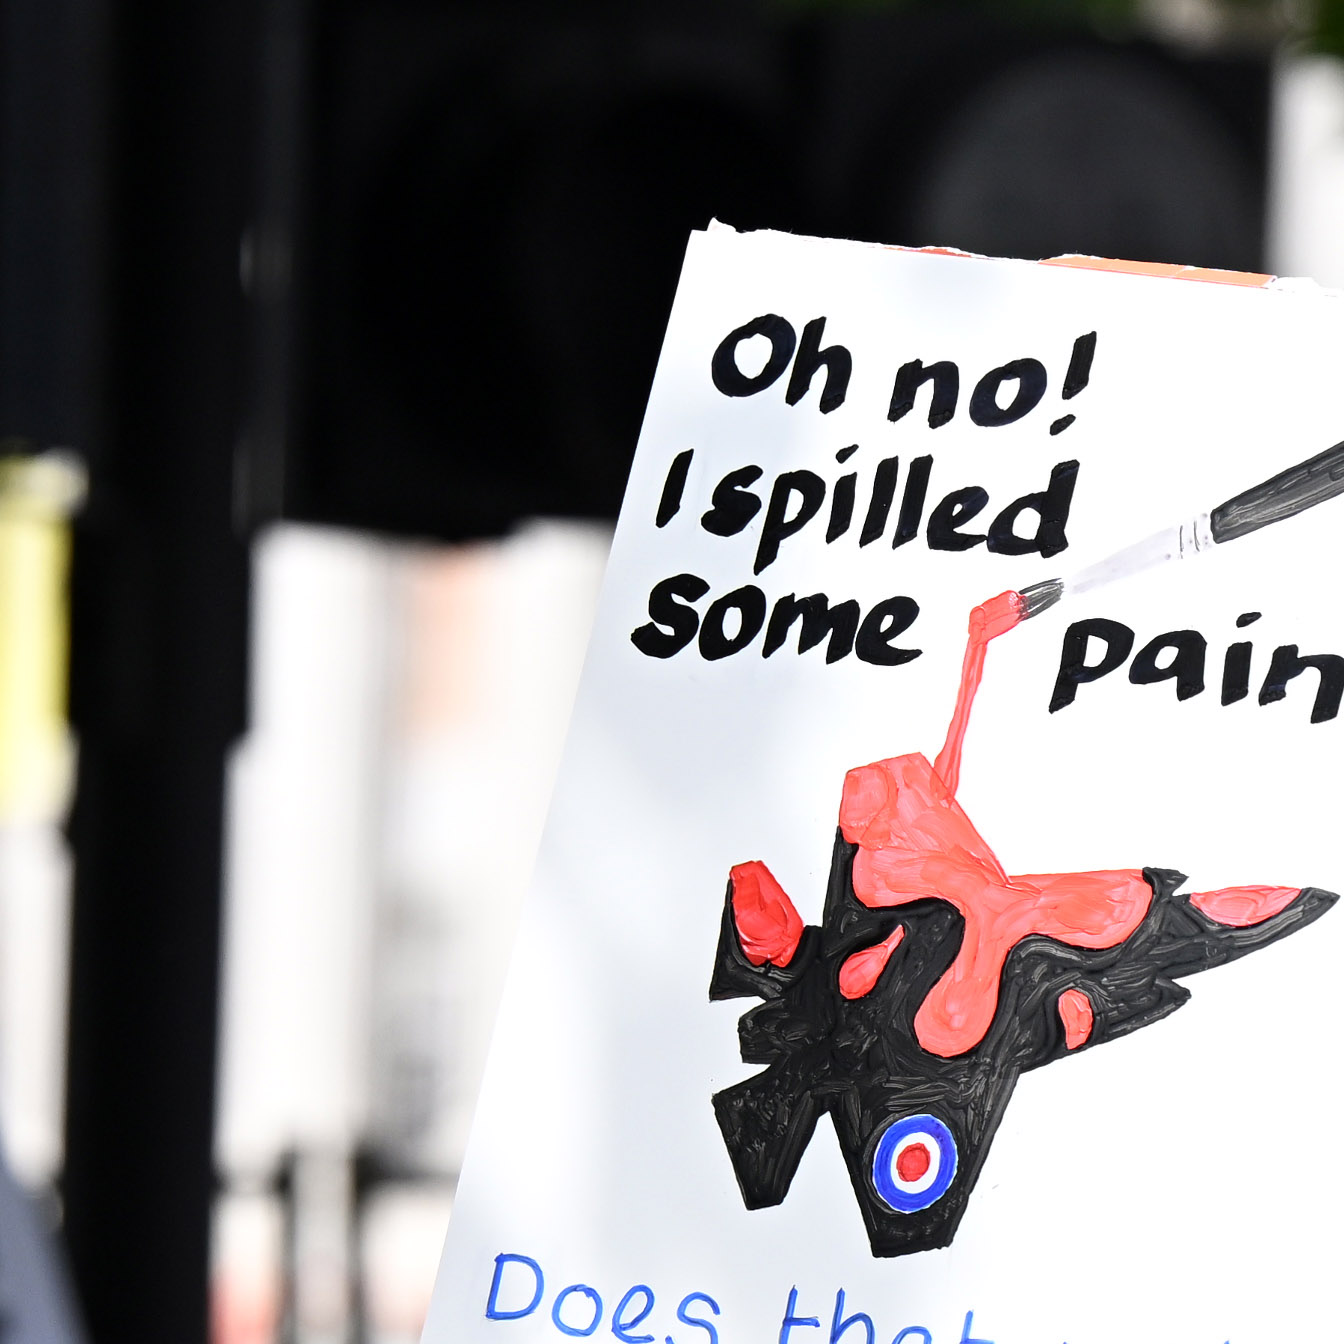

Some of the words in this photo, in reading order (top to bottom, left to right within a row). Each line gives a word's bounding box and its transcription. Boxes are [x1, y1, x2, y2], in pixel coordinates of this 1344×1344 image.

[711, 313, 853, 415] Oh
[887, 330, 1097, 436] no!
[655, 447, 695, 529] I
[700, 442, 1081, 577] spilled
[630, 572, 923, 667] some
